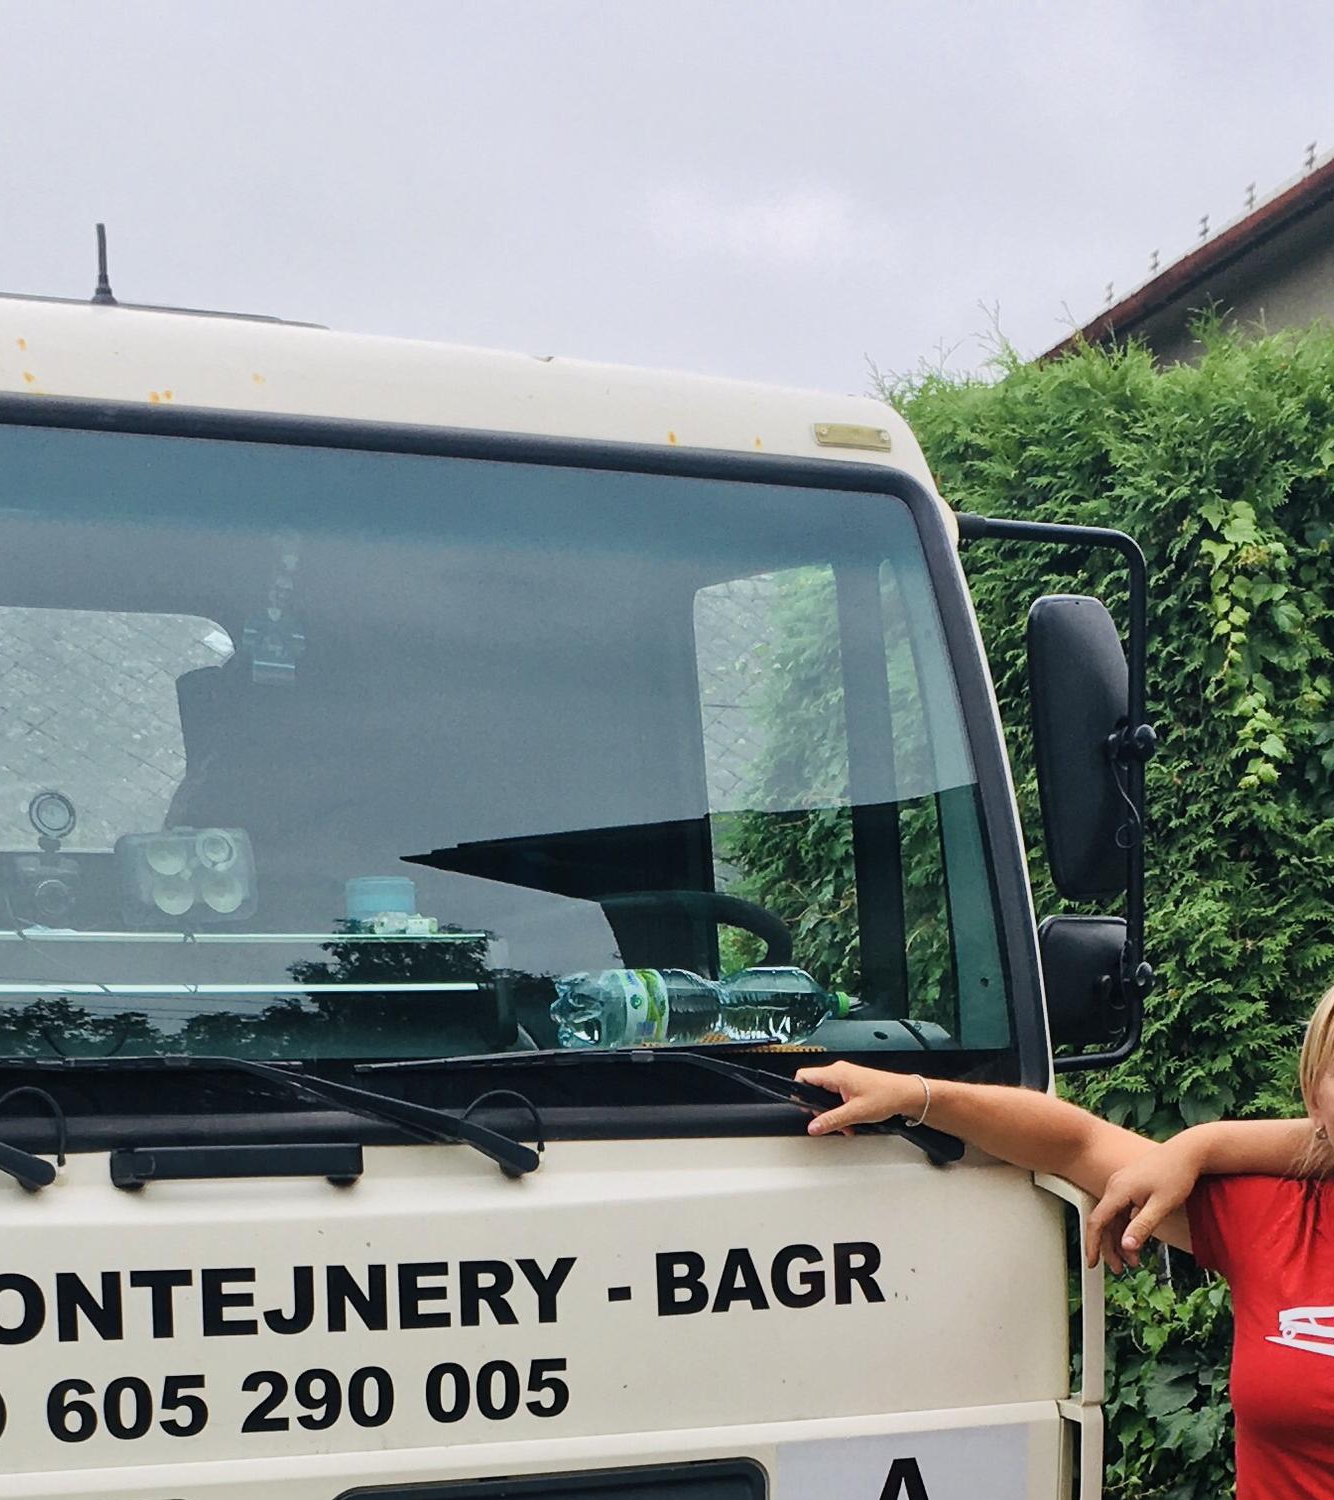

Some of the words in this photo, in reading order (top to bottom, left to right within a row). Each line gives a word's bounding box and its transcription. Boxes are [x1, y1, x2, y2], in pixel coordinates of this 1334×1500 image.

[607, 1285, 632, 1302] -
[655, 1241, 886, 1317] BAGR
[46, 1374, 209, 1443] 605
[241, 1365, 395, 1434] 290
[425, 1357, 570, 1424] 005
